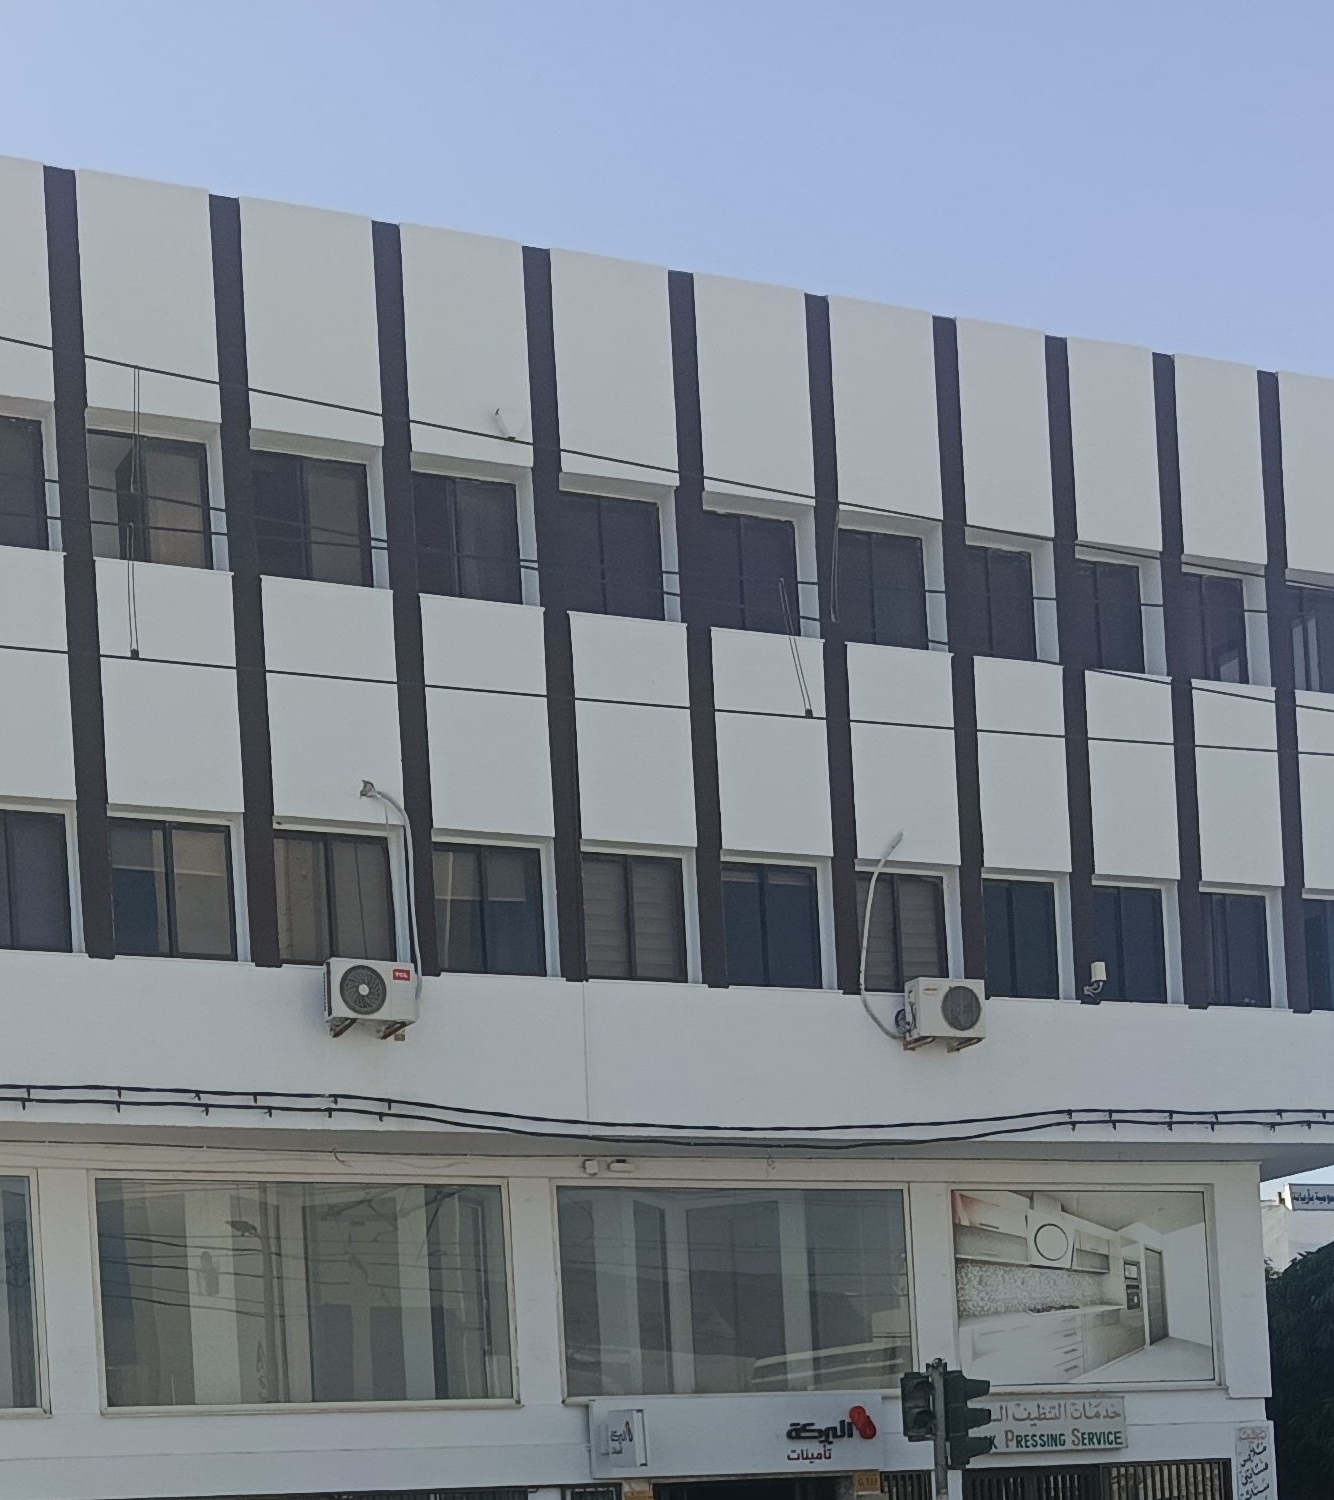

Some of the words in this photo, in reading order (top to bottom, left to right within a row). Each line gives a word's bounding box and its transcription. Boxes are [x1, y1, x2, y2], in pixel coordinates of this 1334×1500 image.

[1012, 1401, 1067, 1427] التنظيف
[1070, 1401, 1122, 1421] خدمات
[786, 1419, 854, 1444] البركة
[1004, 1428, 1066, 1449] PRESSING
[1071, 1427, 1124, 1447] SERVICE
[786, 1445, 832, 1463] تأمينات
